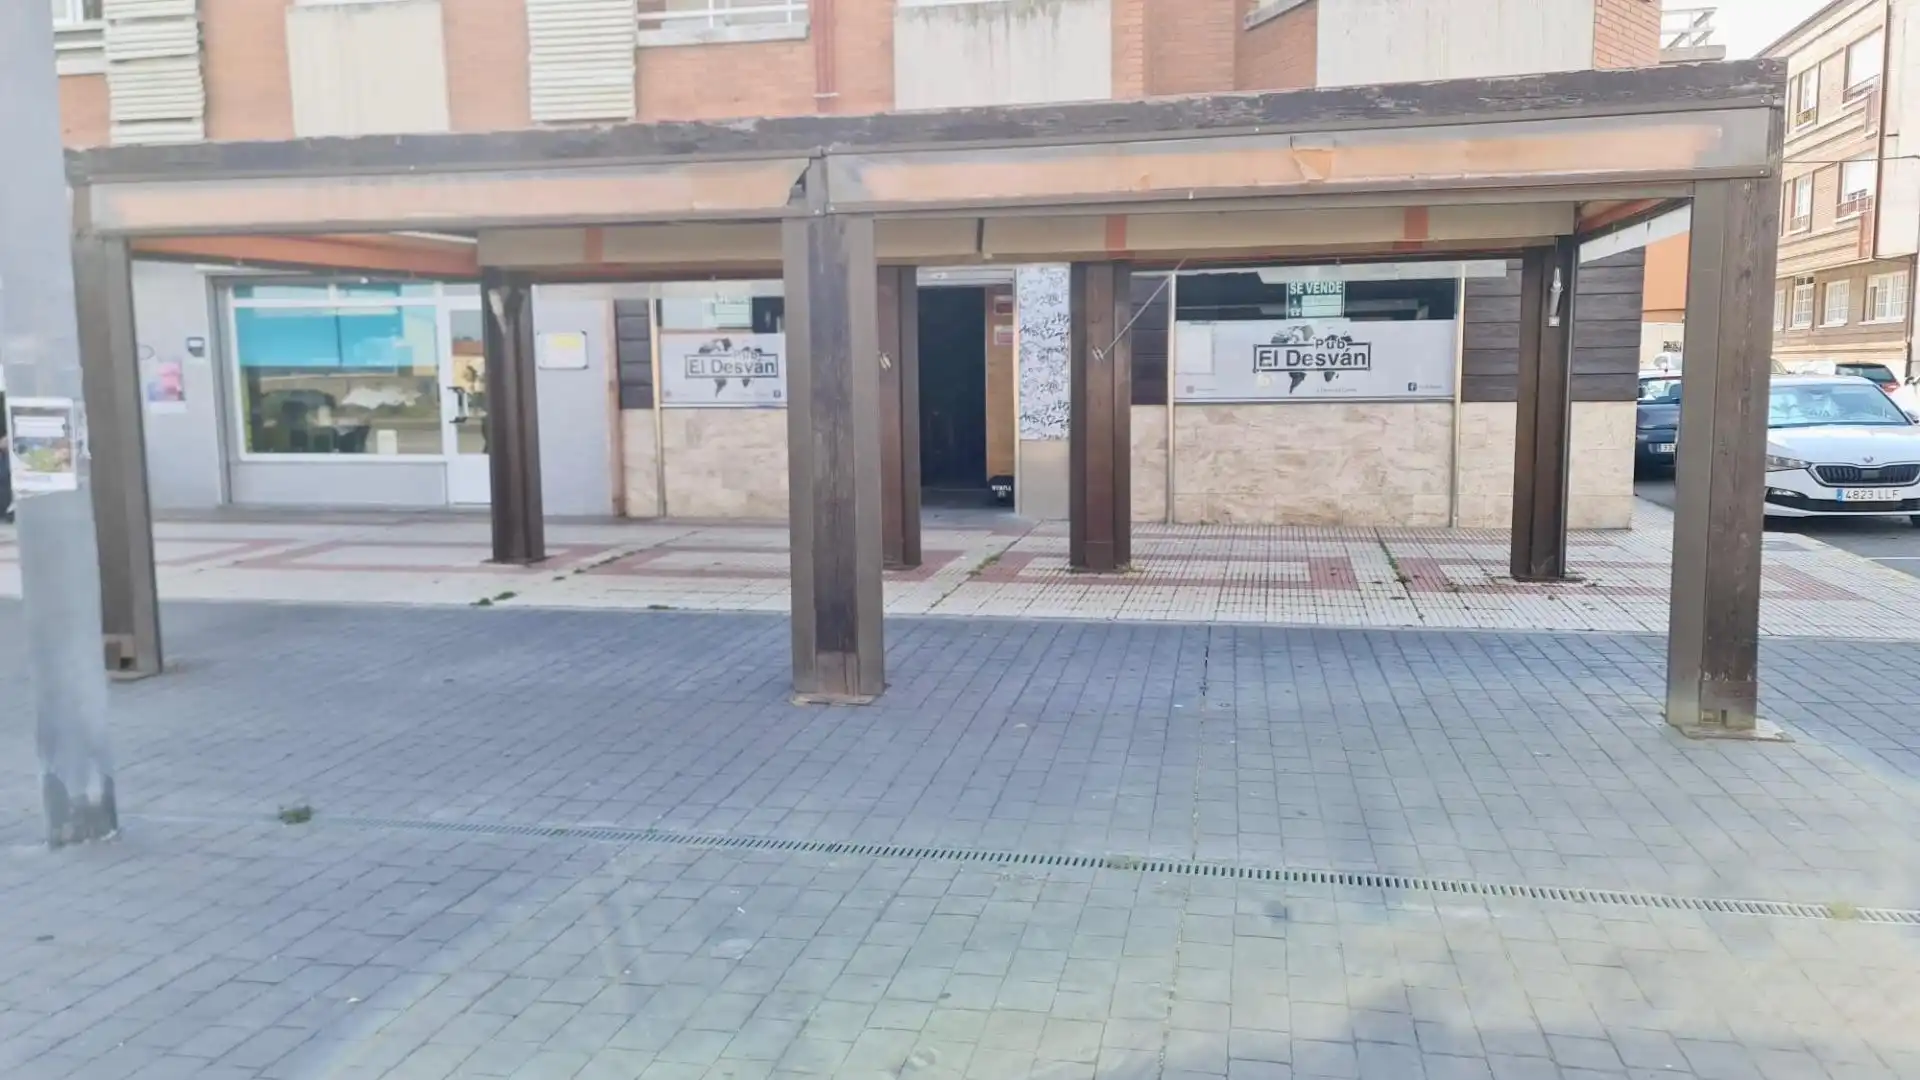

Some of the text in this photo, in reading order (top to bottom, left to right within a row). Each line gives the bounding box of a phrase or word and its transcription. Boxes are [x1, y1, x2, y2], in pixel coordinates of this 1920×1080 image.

[1289, 281, 1343, 295] SE VENDE
[1315, 338, 1346, 350] Pub
[1258, 348, 1366, 367] El Desván
[689, 359, 705, 374] El
[1845, 489, 1899, 501] 4823 LLF
